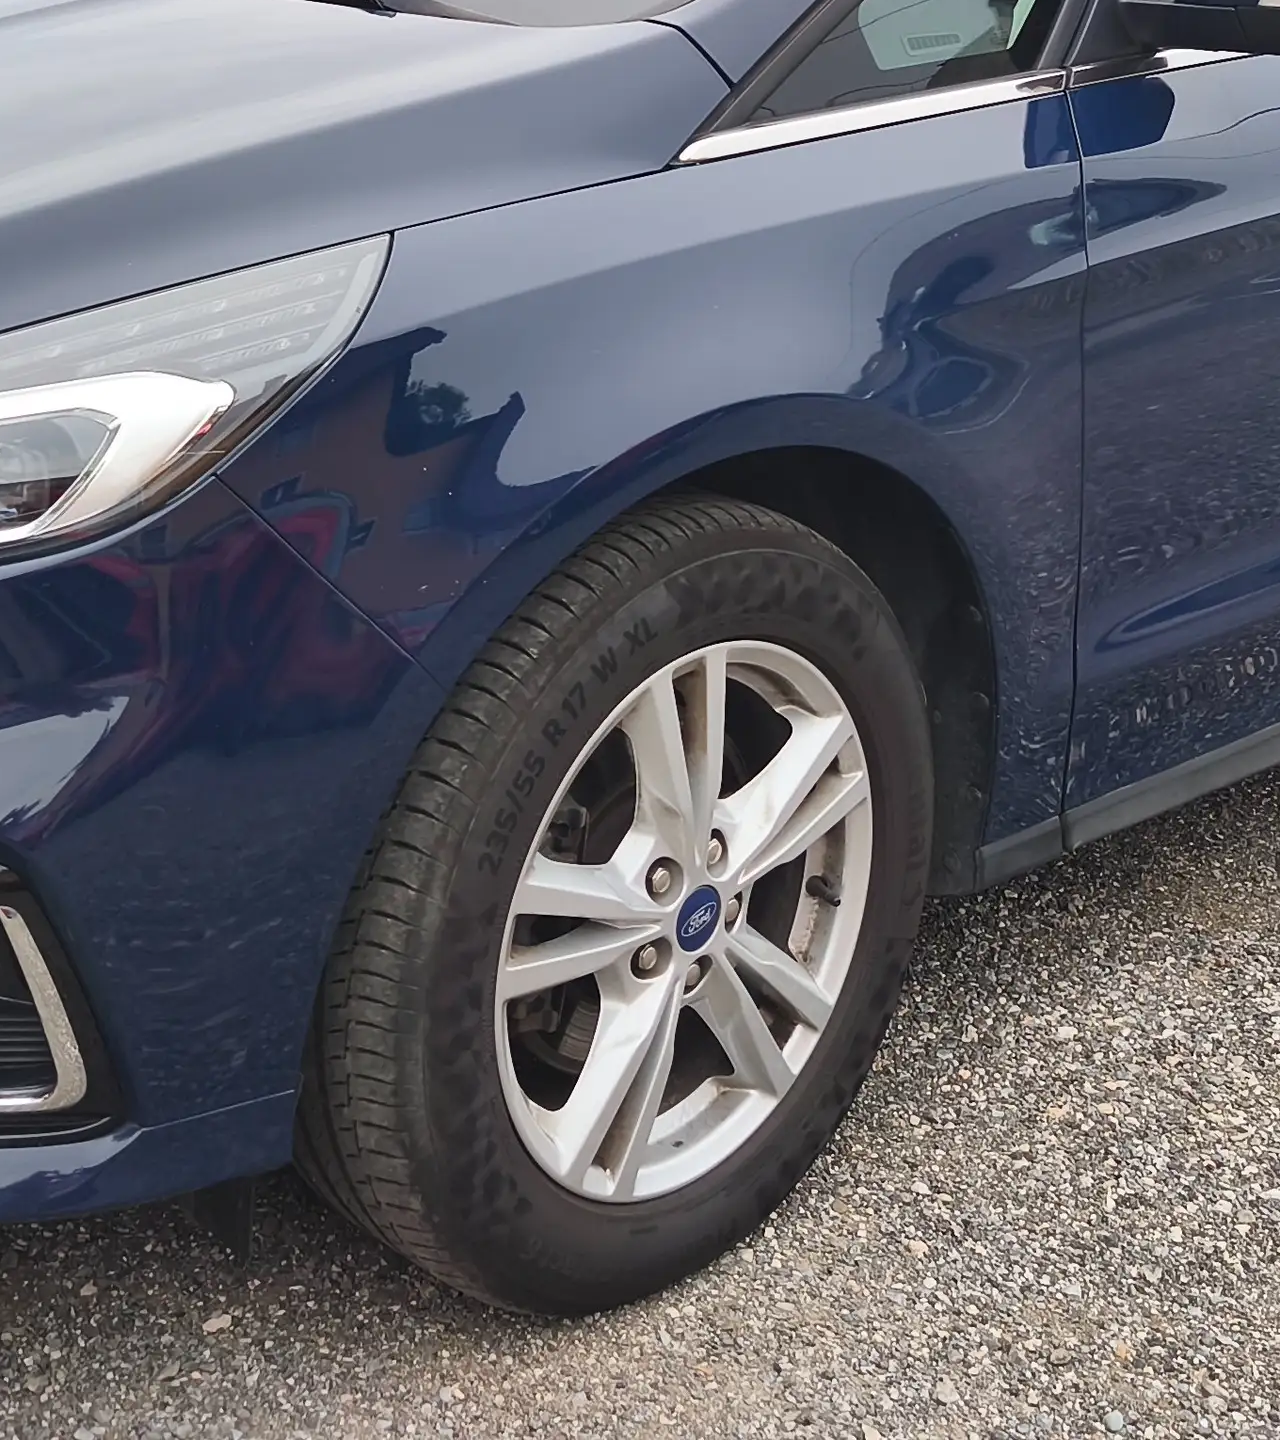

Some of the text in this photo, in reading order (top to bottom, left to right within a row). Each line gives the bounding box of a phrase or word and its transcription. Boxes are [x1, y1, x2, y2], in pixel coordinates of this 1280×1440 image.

[542, 718, 567, 748] R
[562, 681, 587, 720] 17
[590, 646, 619, 685] W
[623, 616, 659, 658] XL
[686, 906, 712, 934] Ford
